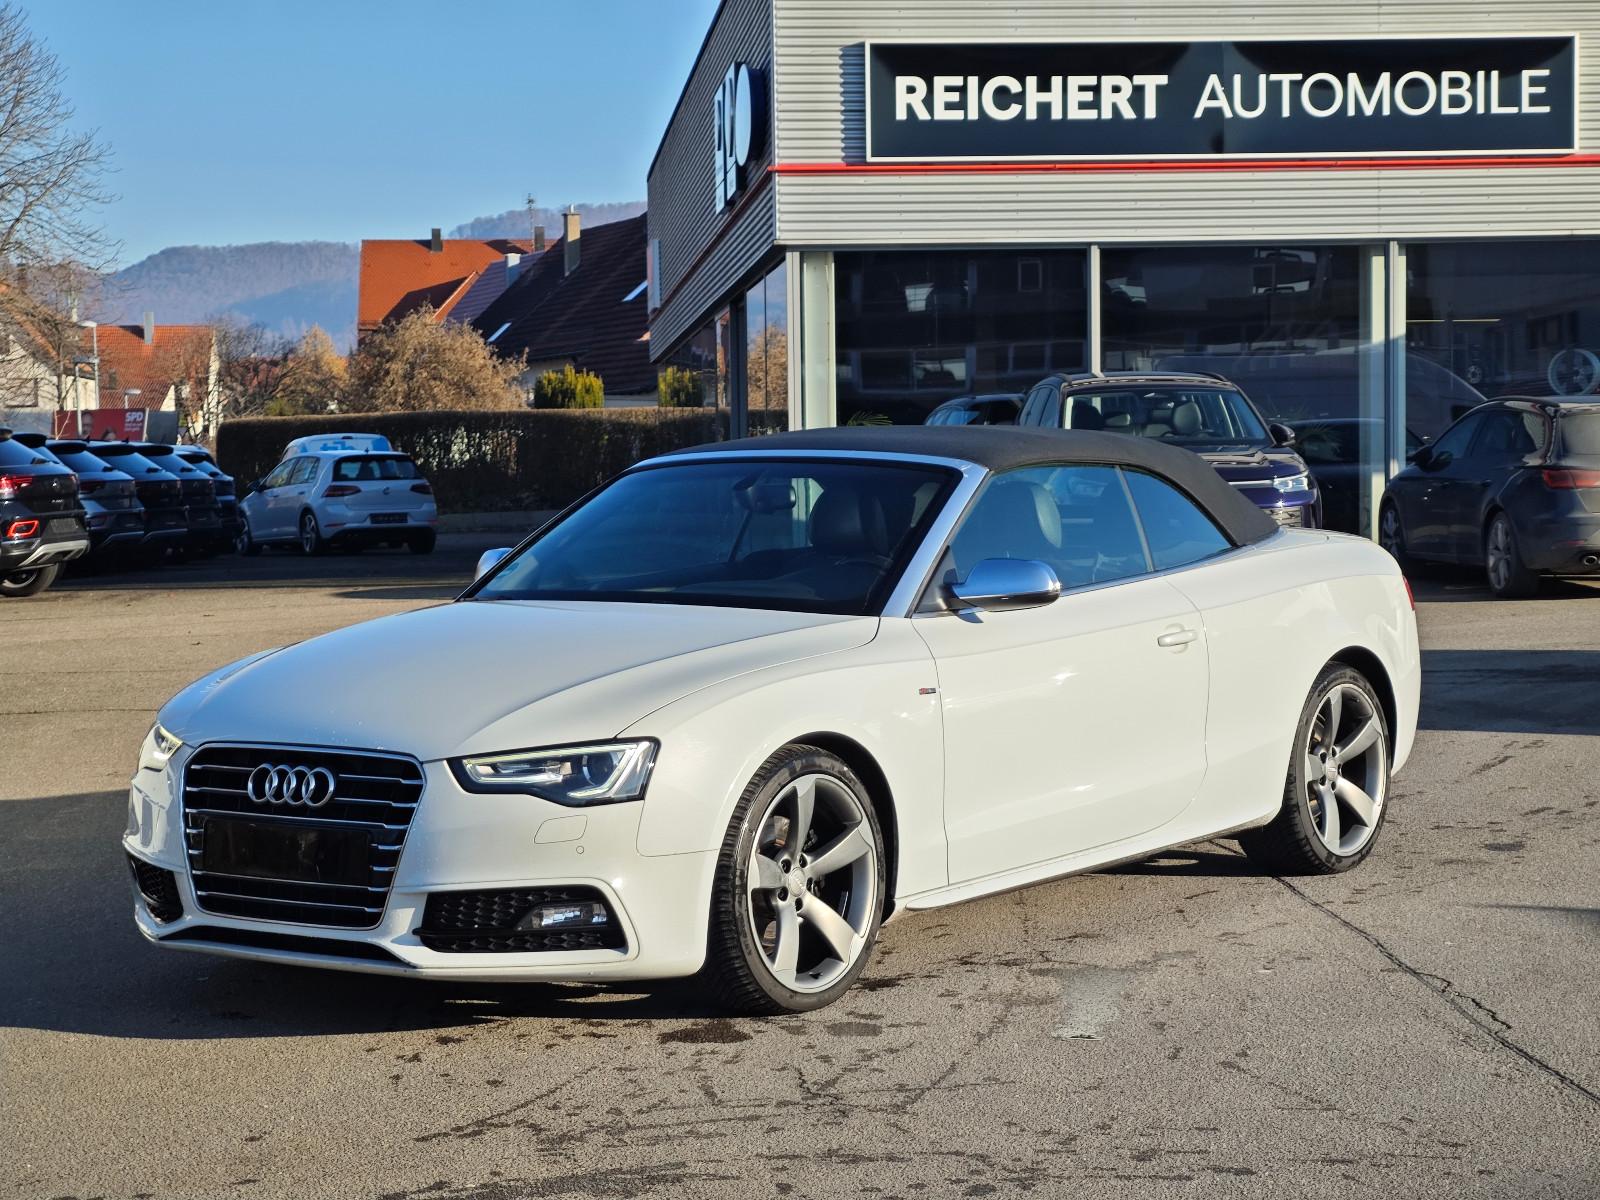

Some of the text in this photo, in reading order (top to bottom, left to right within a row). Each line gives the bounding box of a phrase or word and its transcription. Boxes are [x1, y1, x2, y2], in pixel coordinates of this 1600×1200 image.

[895, 68, 1551, 121] REICHERT AUTOMOBILE
[125, 411, 144, 422] SPD
